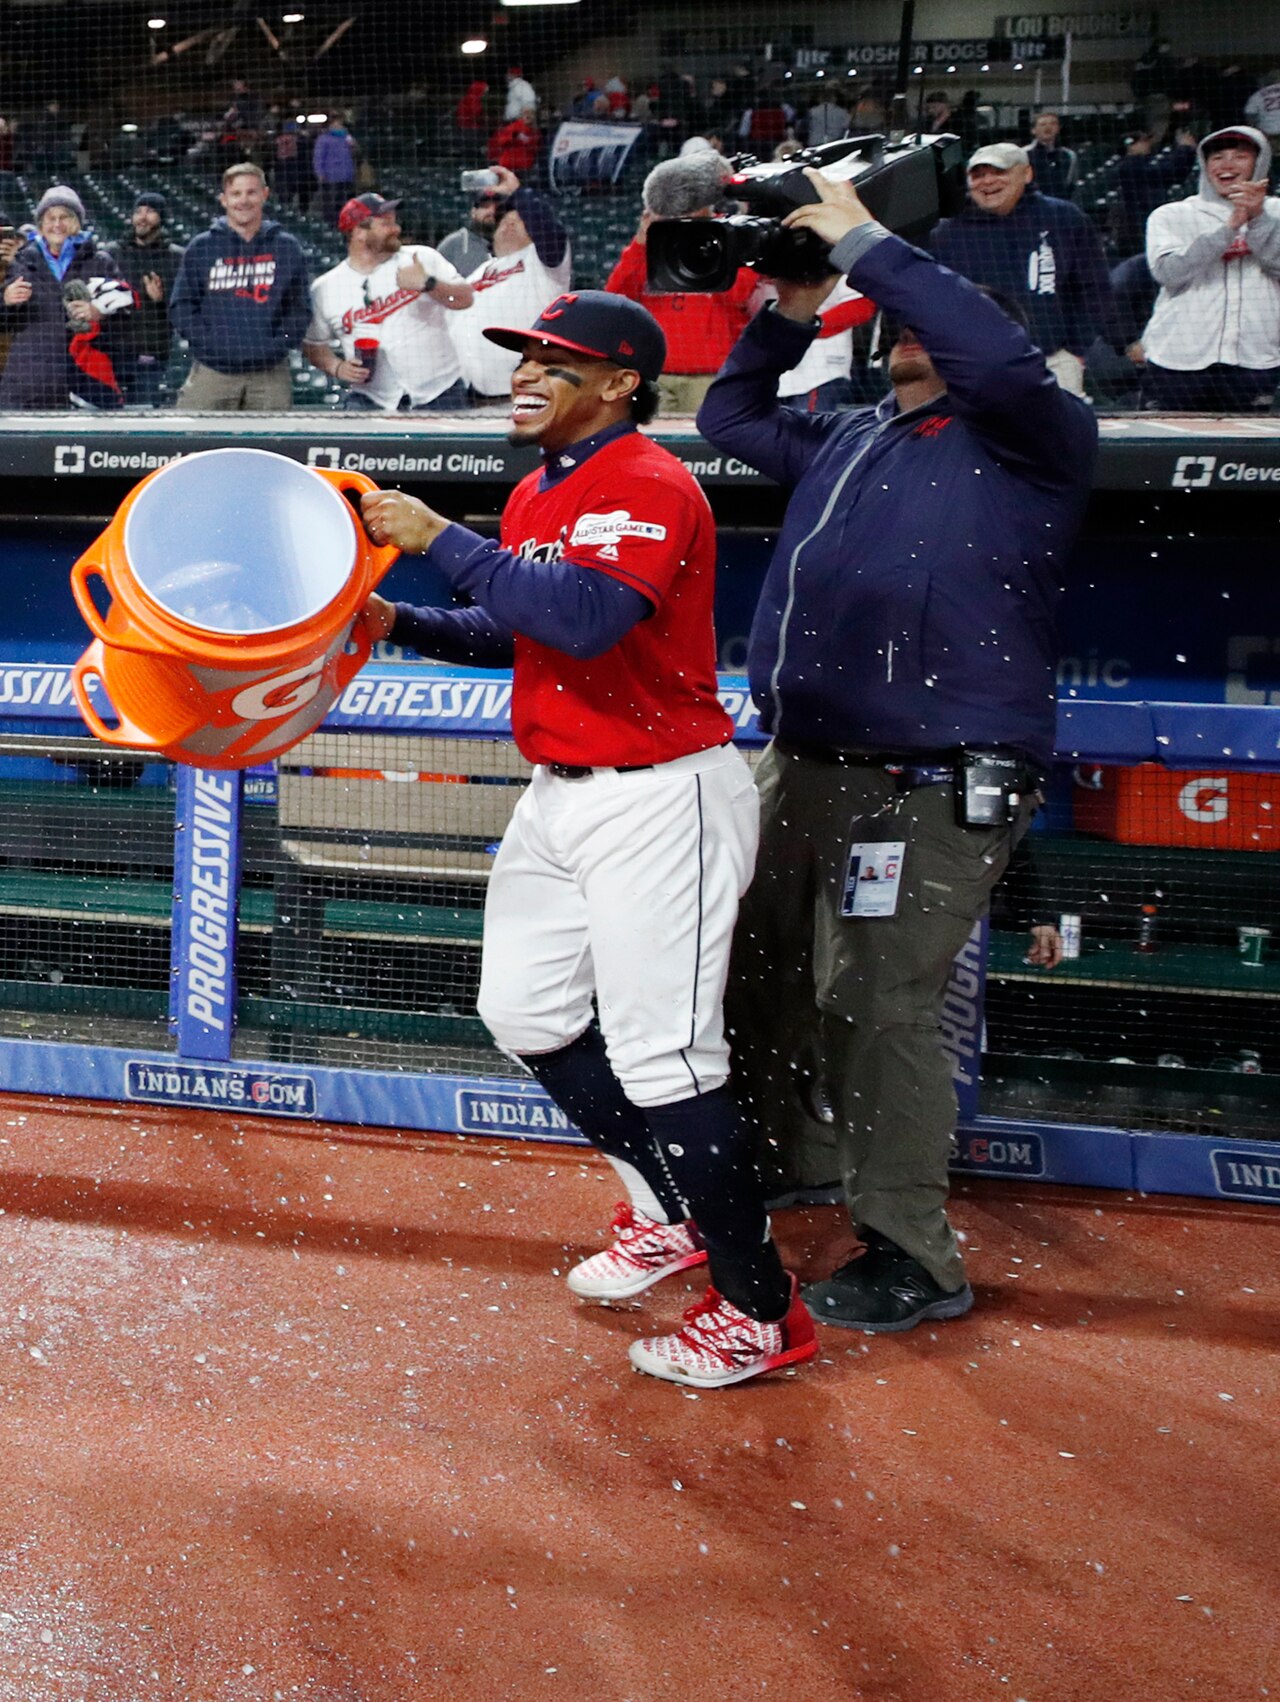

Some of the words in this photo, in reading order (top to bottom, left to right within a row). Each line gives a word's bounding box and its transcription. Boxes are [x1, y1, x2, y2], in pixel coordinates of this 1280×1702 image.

[847, 45, 927, 63] KOSHR
[933, 42, 989, 61] DOGS
[541, 293, 579, 321] C
[343, 452, 443, 473] Cleveland
[446, 453, 505, 474] Clinic
[231, 654, 327, 720] G
[1178, 777, 1229, 824] G
[188, 768, 232, 1031] PROGRESSIVE
[138, 1071, 307, 1107] INDIANS.COM
